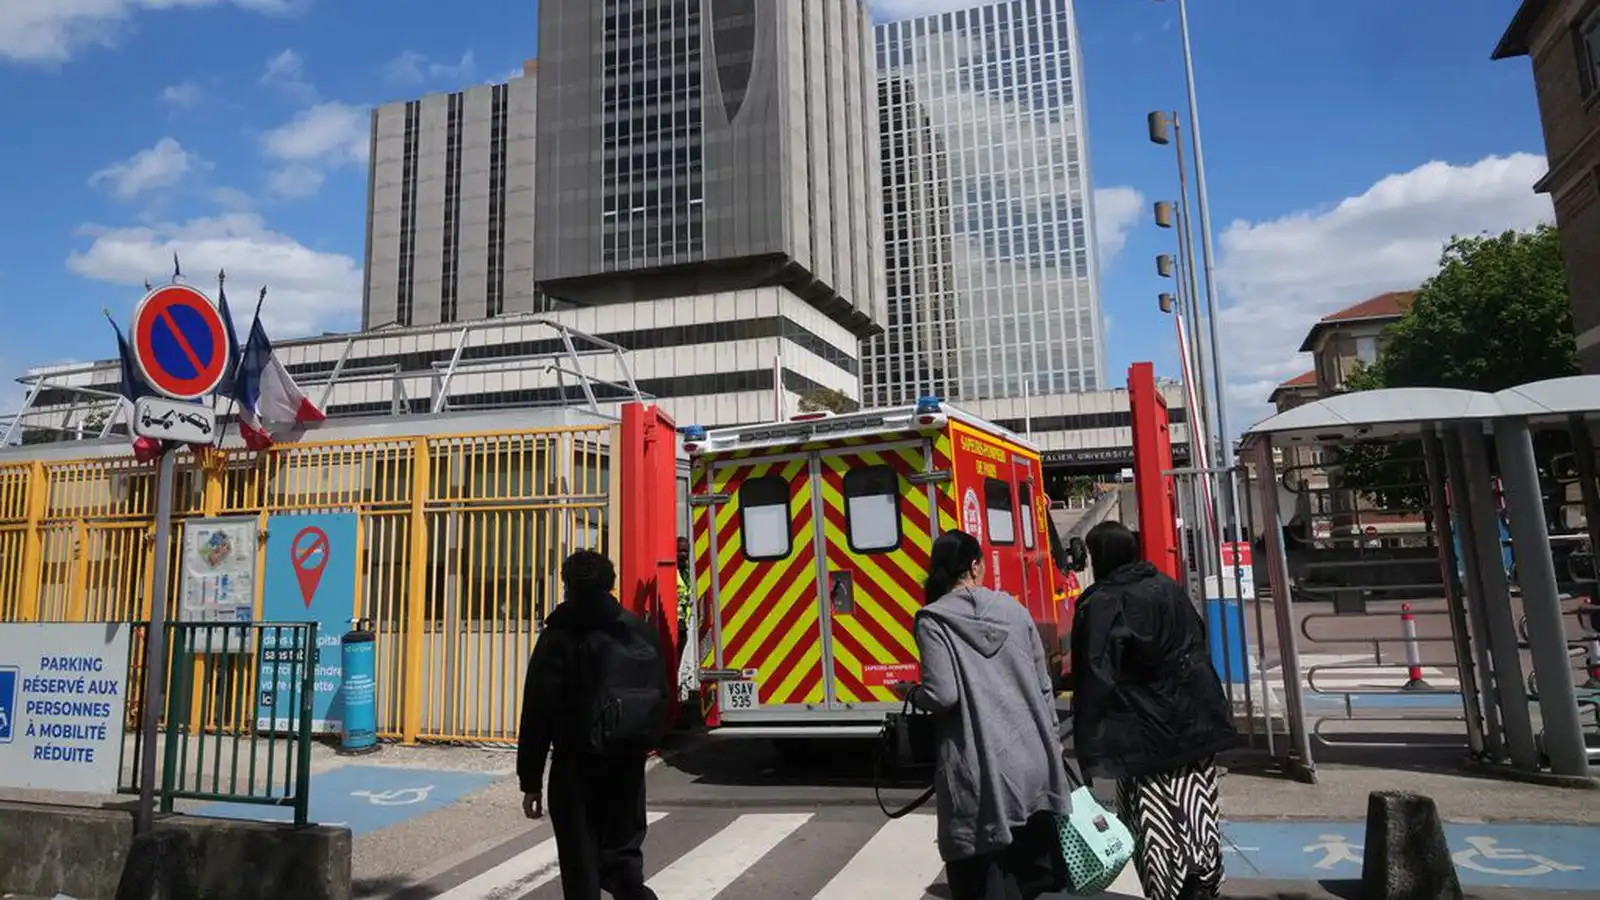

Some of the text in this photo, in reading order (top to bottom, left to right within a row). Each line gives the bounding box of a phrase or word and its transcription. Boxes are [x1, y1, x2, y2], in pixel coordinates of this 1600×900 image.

[1077, 450, 1134, 460] UNIVERSITA
[40, 657, 103, 672] PARKING
[23, 675, 118, 695] RÉSERVÉ AUX
[728, 683, 754, 695] VSAV
[26, 700, 111, 717] PERSONNES
[731, 696, 752, 708] 535
[25, 719, 108, 740] À MOBILITÉ
[33, 742, 95, 763] RÉDUITE
